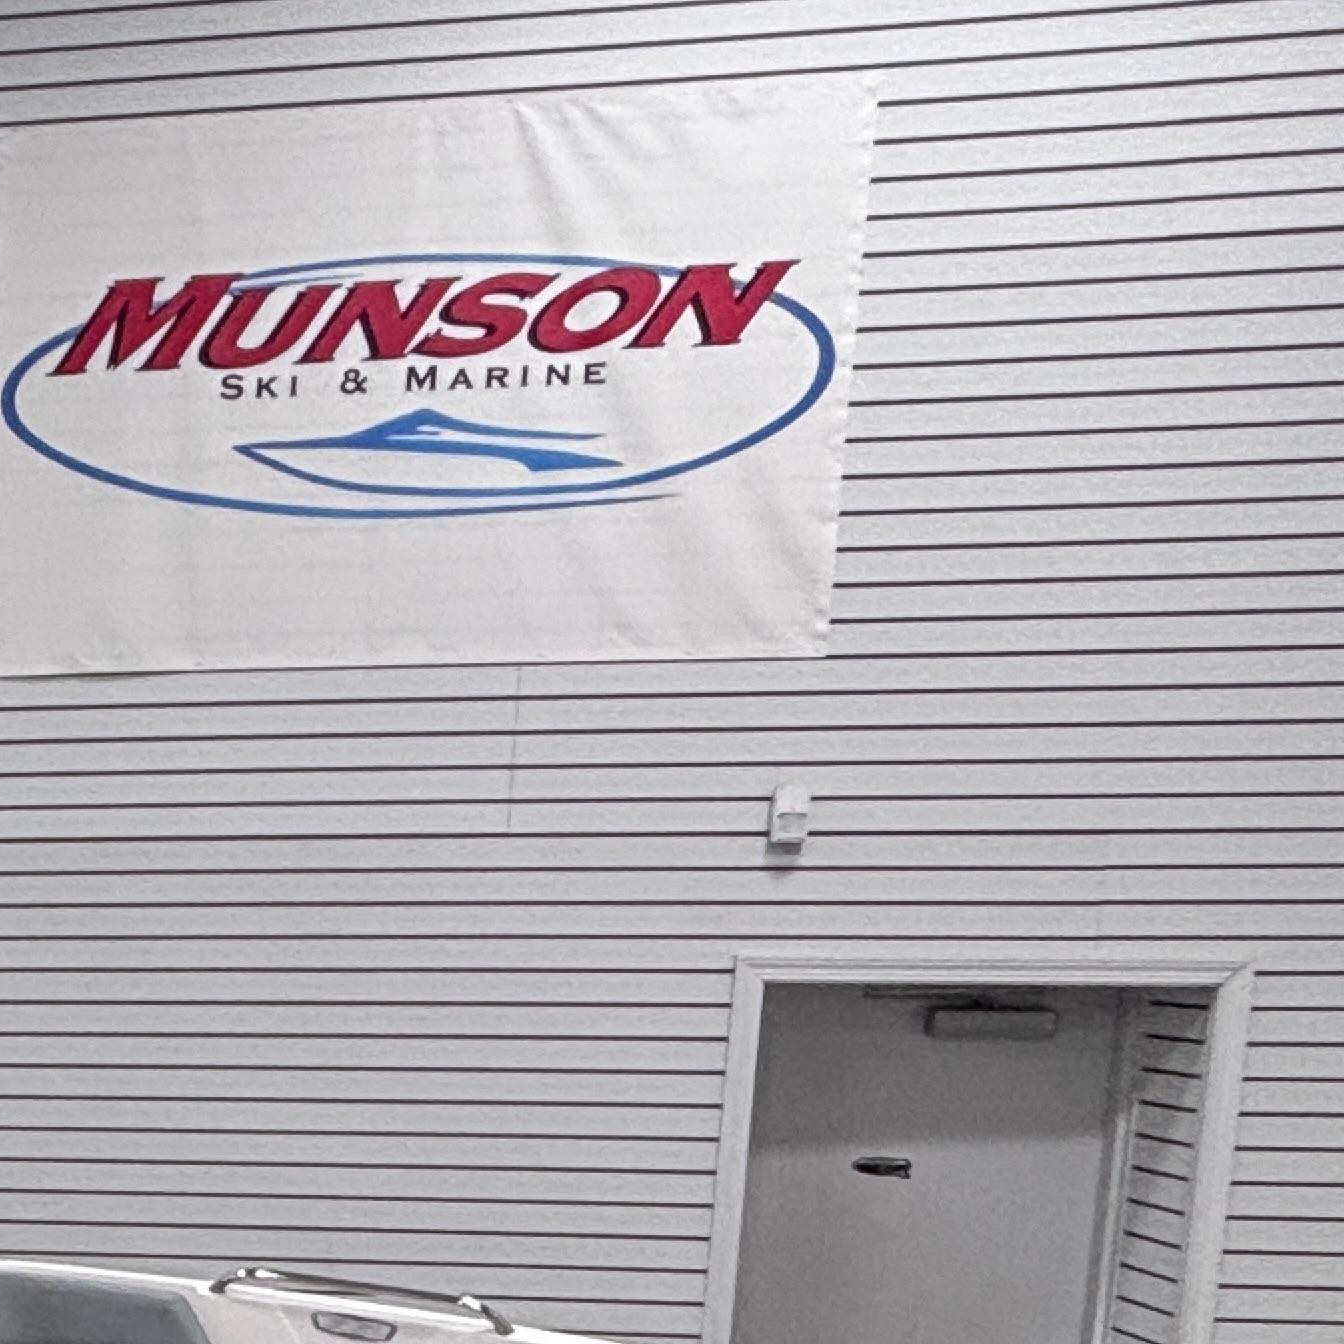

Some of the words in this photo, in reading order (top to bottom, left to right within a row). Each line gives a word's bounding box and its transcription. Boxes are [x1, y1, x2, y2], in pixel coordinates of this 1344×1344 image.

[46, 259, 801, 376] MUNSON
[220, 373, 298, 400] SKI
[340, 369, 368, 394] &
[405, 361, 608, 392] MARINE
